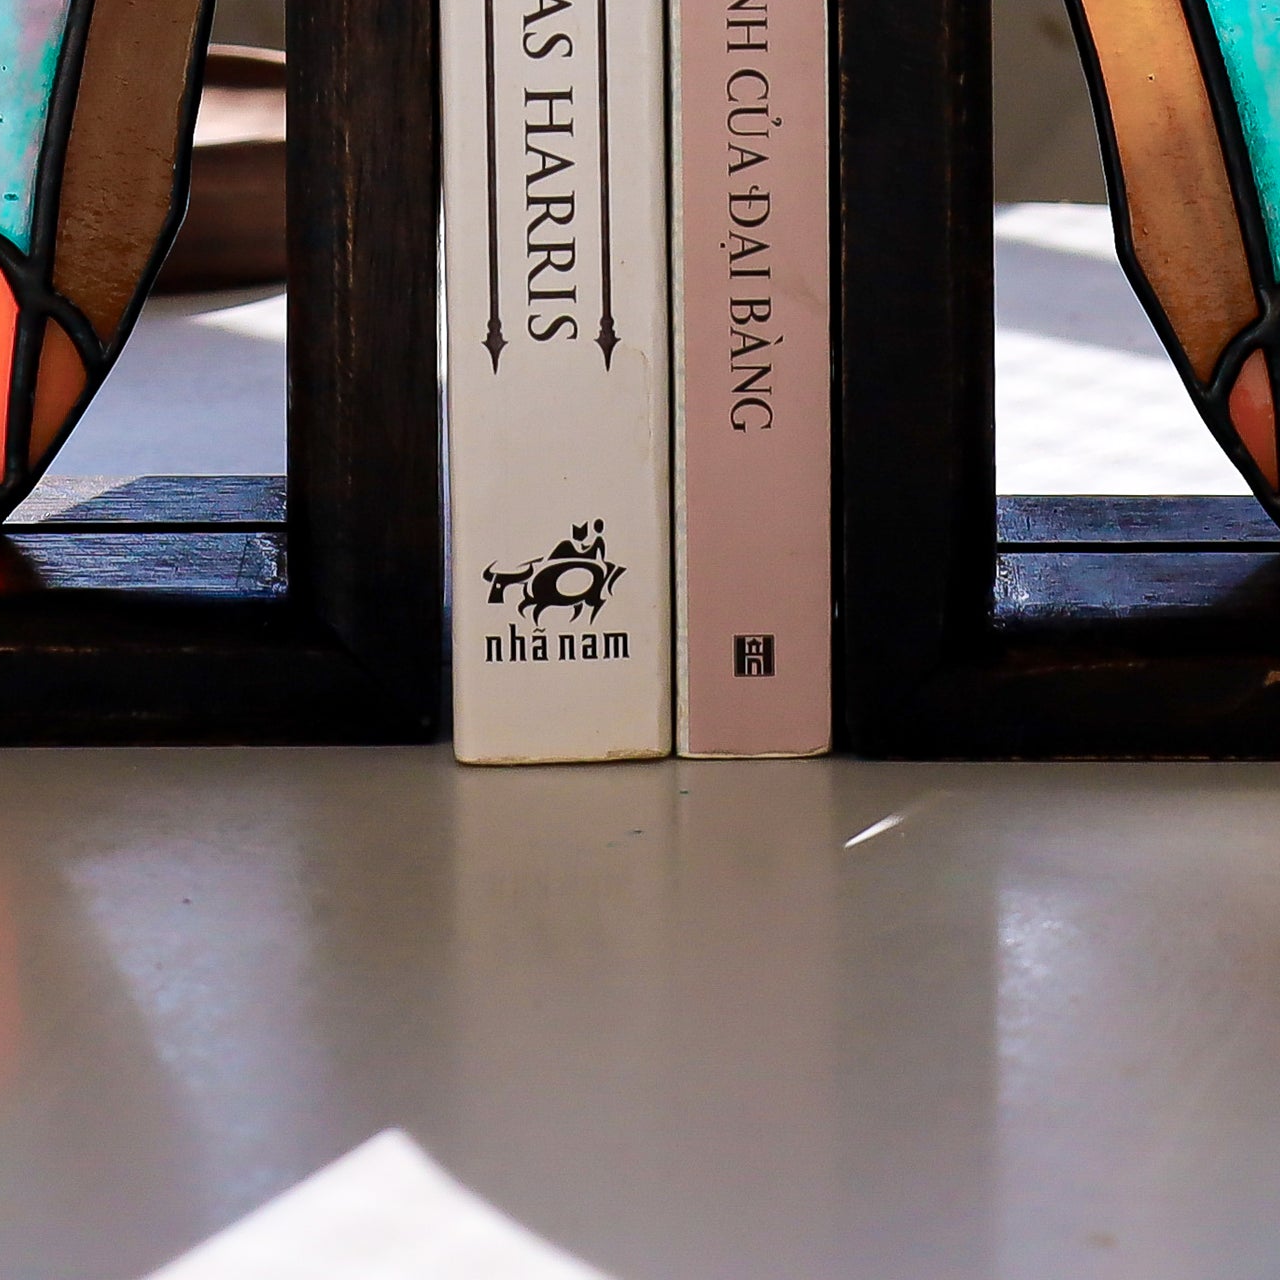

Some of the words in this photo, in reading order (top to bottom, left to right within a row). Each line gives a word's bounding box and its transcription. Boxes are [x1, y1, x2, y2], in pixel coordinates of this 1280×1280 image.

[727, 69, 782, 176] CỦA
[524, 86, 577, 341] HARRIS
[720, 185, 771, 279] ĐẠI
[730, 296, 783, 433] BÀNG
[559, 633, 629, 660] nam
